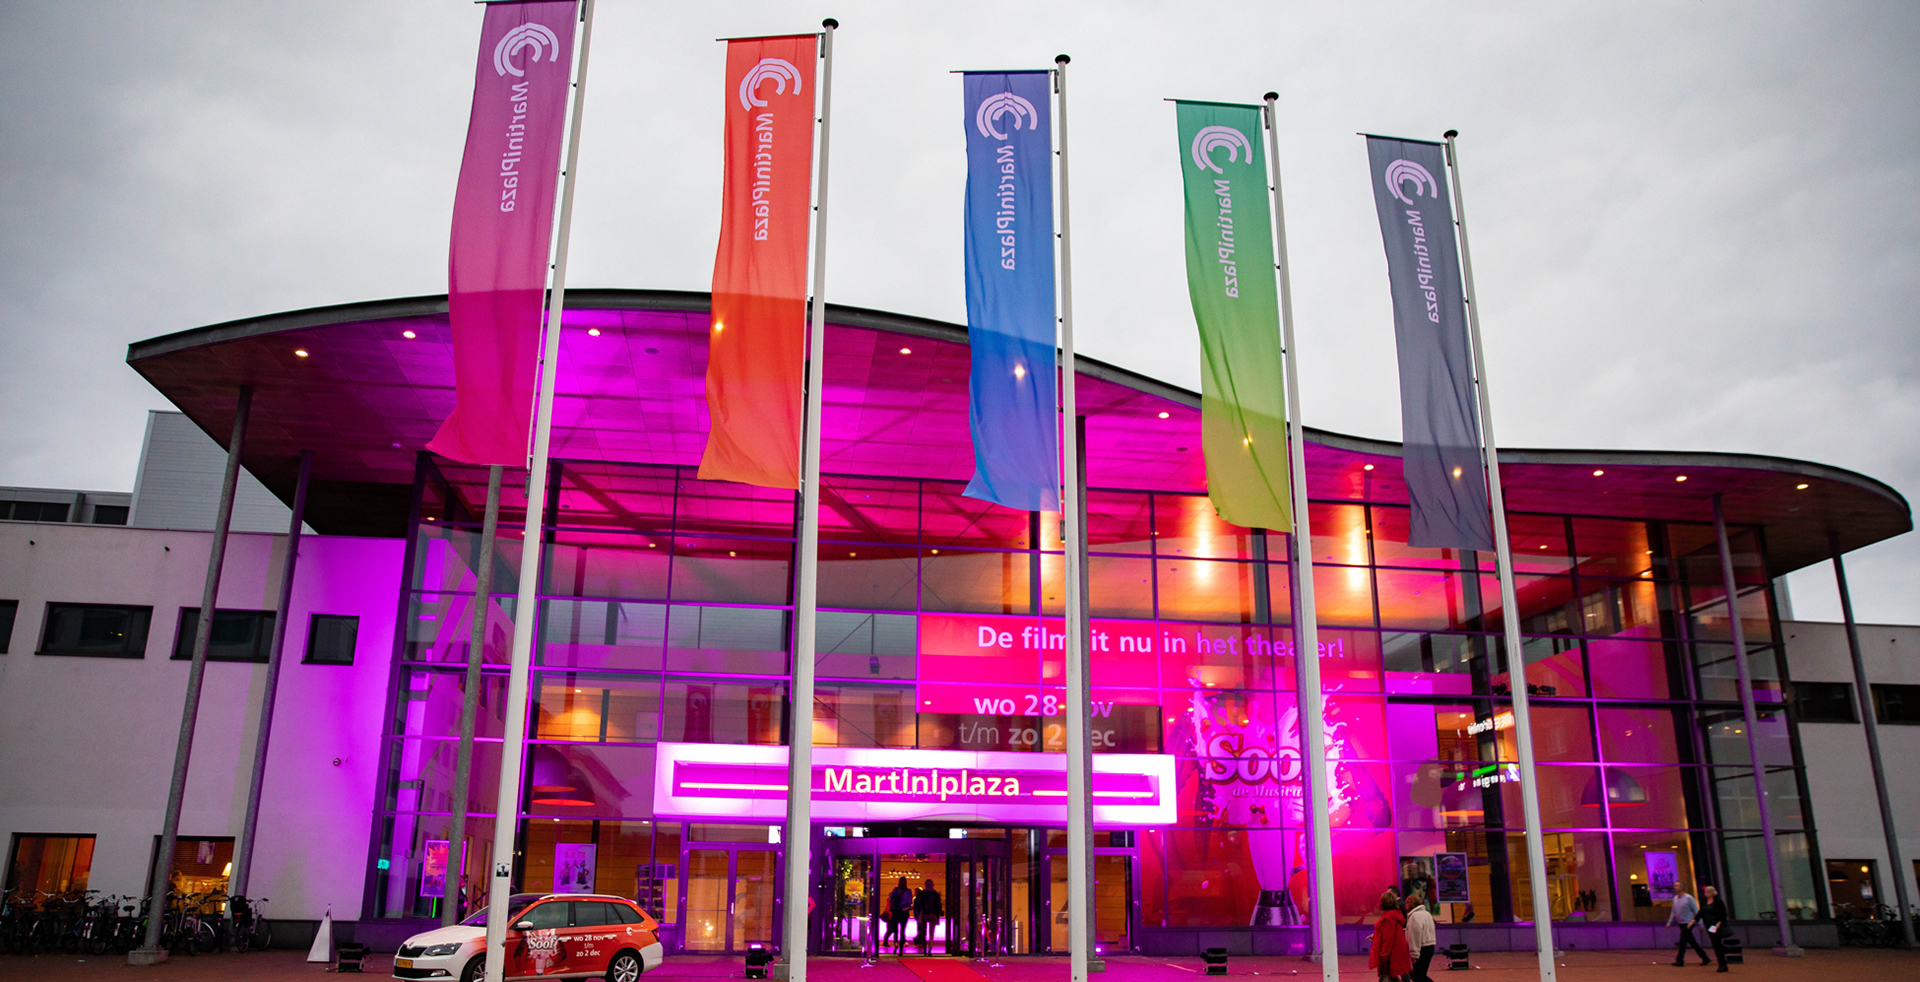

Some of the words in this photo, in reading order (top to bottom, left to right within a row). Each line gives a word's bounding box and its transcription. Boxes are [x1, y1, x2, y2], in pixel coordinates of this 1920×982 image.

[978, 625, 1013, 649] De
[1021, 626, 1109, 652] filmit
[1120, 636, 1152, 653] nu
[1163, 631, 1187, 653] in
[1196, 631, 1238, 656] het
[1245, 633, 1345, 659] theaer!
[974, 698, 1016, 716] wo
[1024, 694, 1059, 717] 28
[958, 721, 999, 745] t/m
[1008, 728, 1039, 746] zo
[1047, 723, 1063, 746] 2
[1204, 733, 1304, 784] Soo
[824, 767, 1020, 802] Martiniplaza
[1232, 784, 1249, 797] de
[1254, 784, 1303, 798] Musica
[528, 936, 557, 949] Soof
[585, 934, 592, 942] 28
[585, 949, 589, 957] 2
[590, 949, 600, 957] dec
